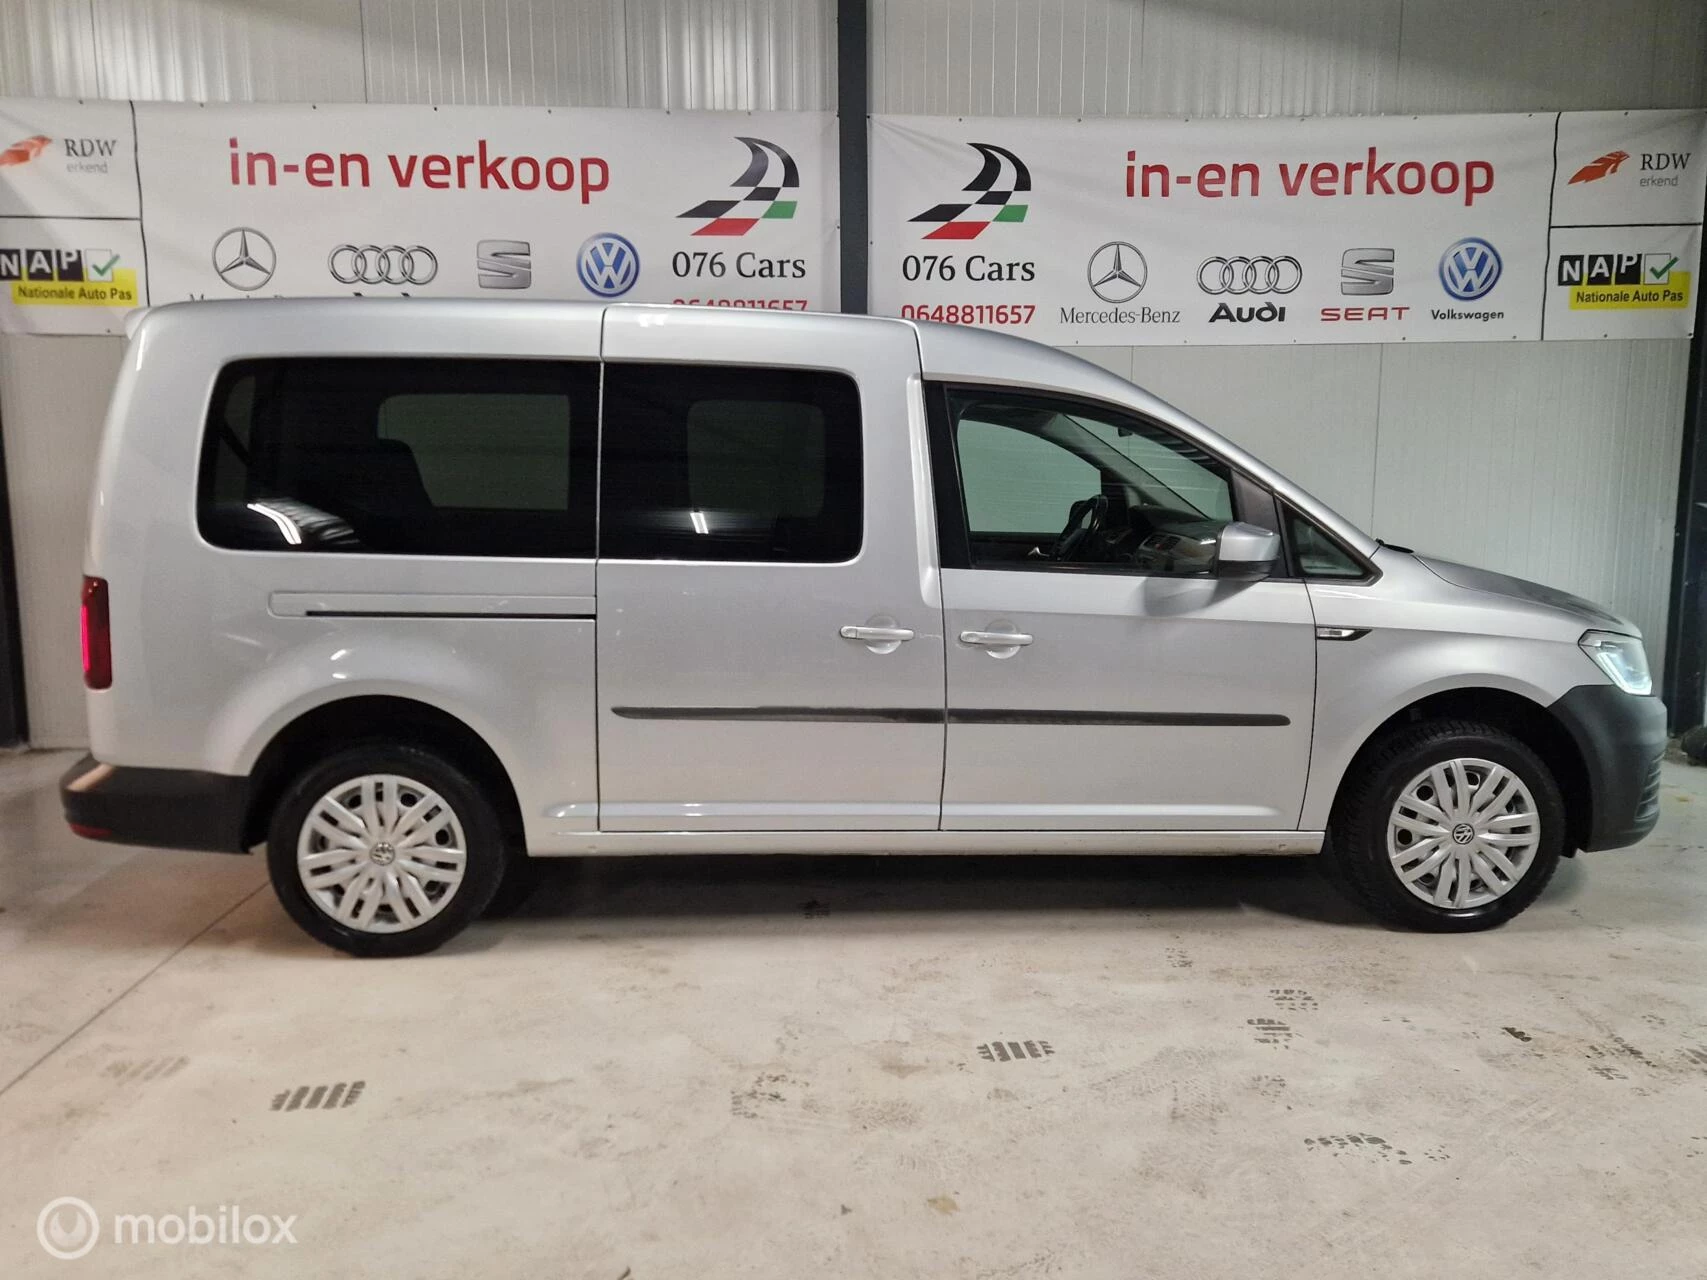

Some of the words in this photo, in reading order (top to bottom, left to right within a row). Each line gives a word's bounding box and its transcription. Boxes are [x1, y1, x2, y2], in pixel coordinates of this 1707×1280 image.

[64, 138, 117, 158] RDW
[66, 161, 108, 174] erkend
[229, 137, 371, 187] in-en
[387, 139, 610, 205] verkoop
[1639, 152, 1692, 171] RDW
[1125, 150, 1260, 198] in-en
[1278, 146, 1495, 207] verkoop
[1639, 175, 1680, 188] erkend
[0, 249, 78, 277] NAP
[672, 250, 726, 278] 076
[736, 251, 807, 279] Cars
[901, 255, 956, 282] 076
[965, 255, 1036, 282] Cars
[1562, 253, 1638, 282] NAP
[18, 285, 75, 300] Nationale
[78, 287, 107, 301] Auto
[110, 288, 132, 301] Pas
[1576, 291, 1630, 303] Nationale
[1632, 289, 1660, 303] Auto
[1663, 288, 1684, 302] Pas
[901, 304, 1036, 324] 0648811657
[1059, 306, 1181, 324] Mercedes-Benz
[1208, 301, 1287, 323] Audi
[1320, 306, 1411, 321] SEAT
[1431, 308, 1504, 322] Volkswagen
